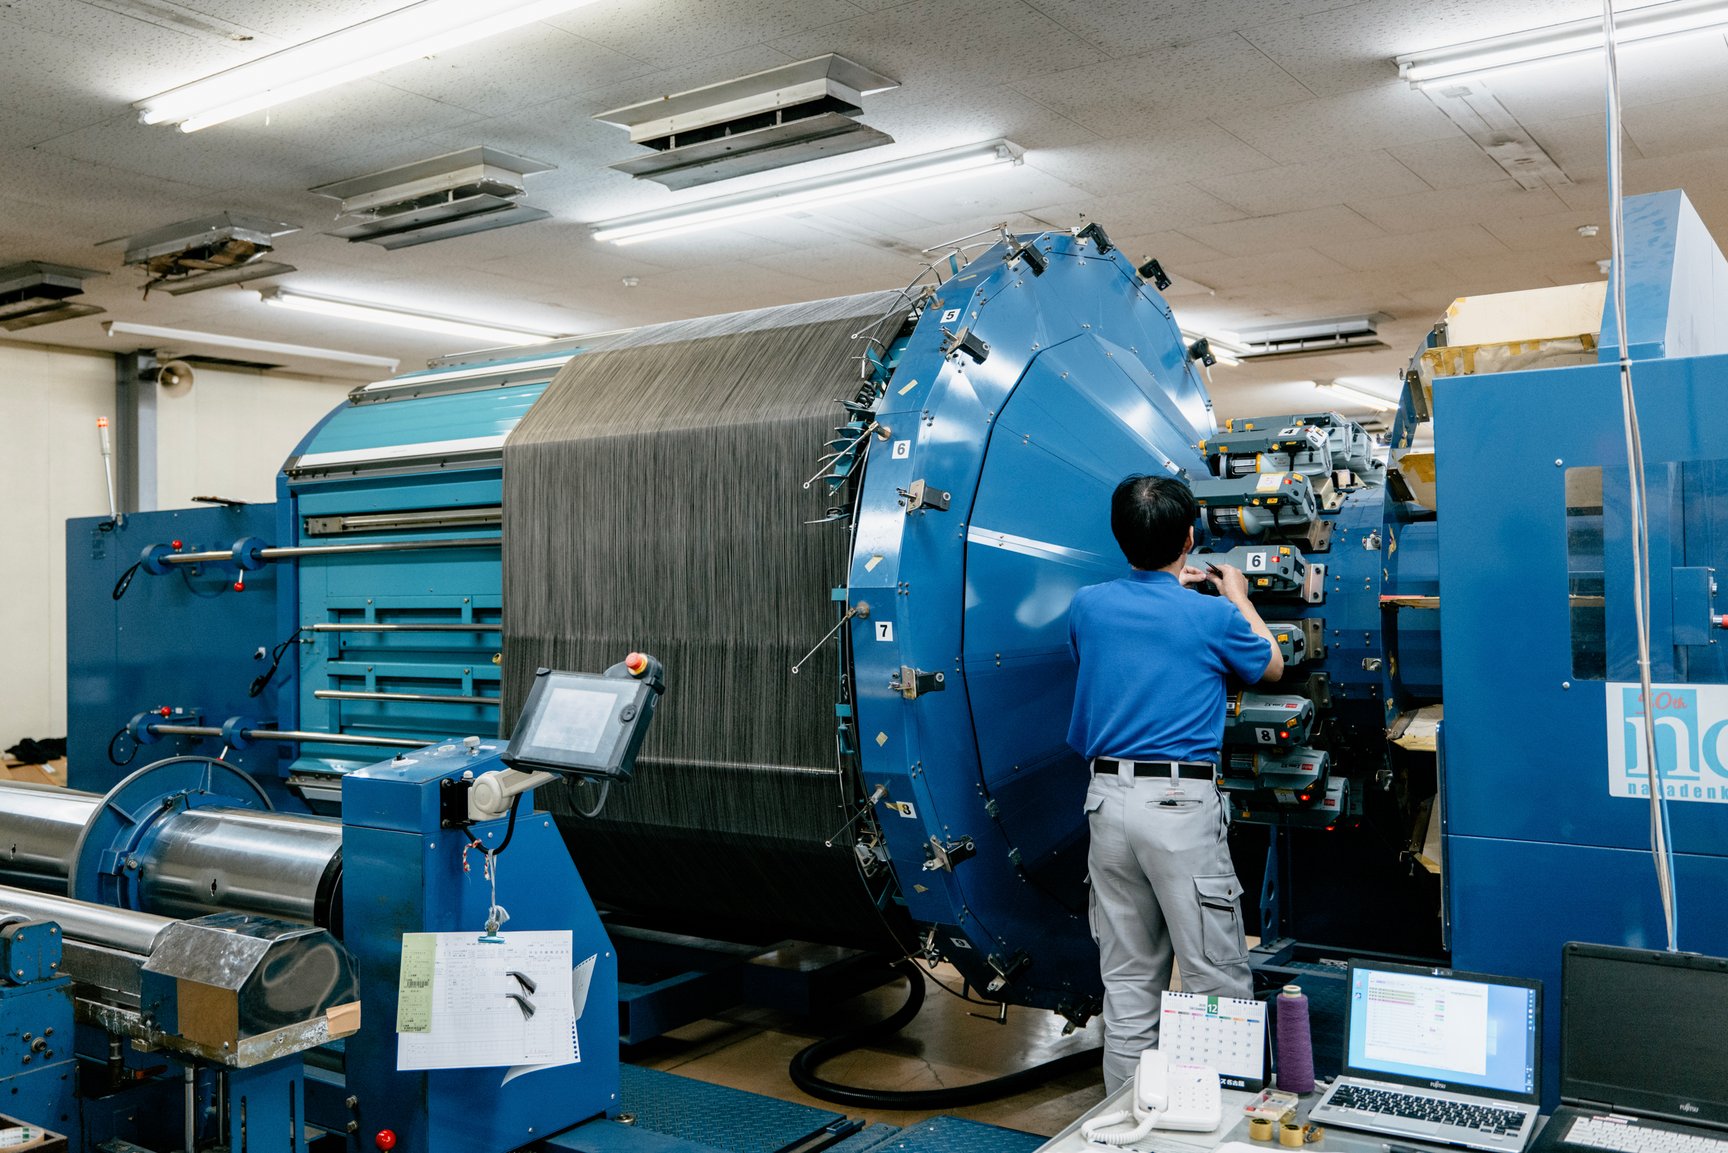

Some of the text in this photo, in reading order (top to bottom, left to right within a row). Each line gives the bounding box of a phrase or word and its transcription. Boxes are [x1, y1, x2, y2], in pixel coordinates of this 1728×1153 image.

[946, 310, 955, 320] 5
[897, 443, 906, 455] 6
[1251, 555, 1262, 567] 6
[880, 624, 888, 638] 7
[1636, 691, 1687, 714] 0th
[1261, 730, 1272, 742] 8
[1628, 783, 1728, 799] naadenk
[902, 804, 911, 815] 8
[1207, 1004, 1218, 1013] 12
